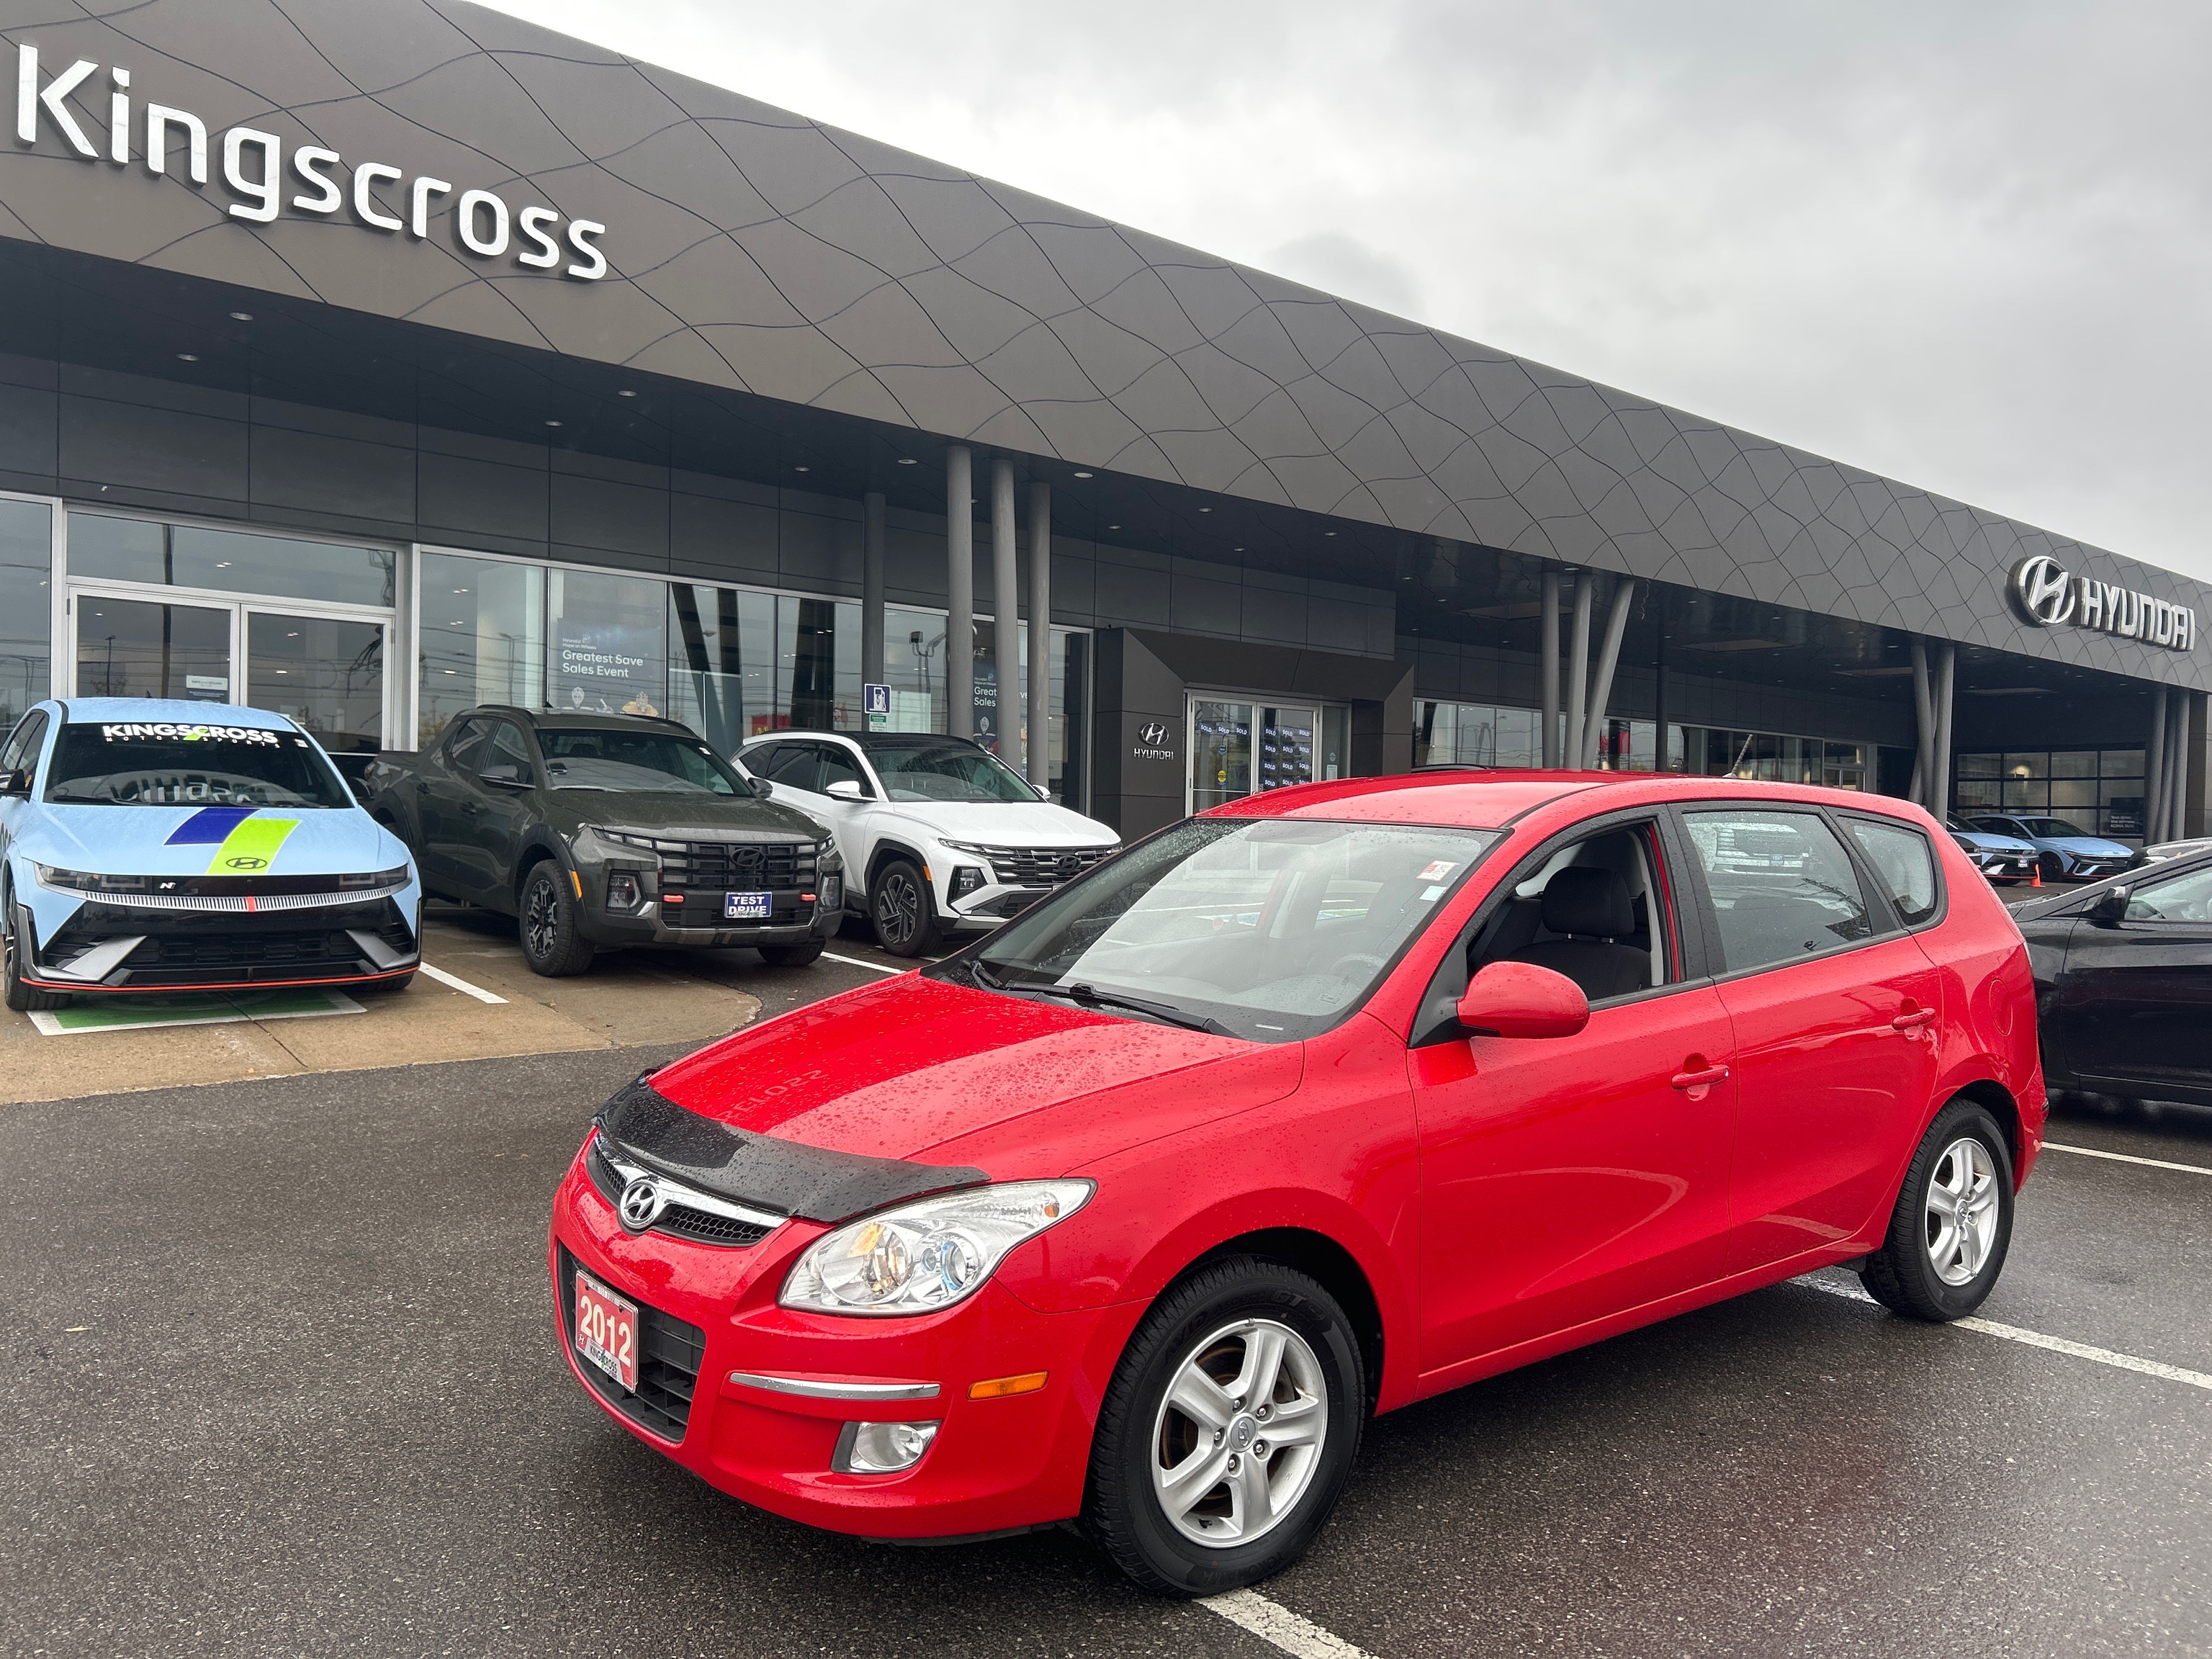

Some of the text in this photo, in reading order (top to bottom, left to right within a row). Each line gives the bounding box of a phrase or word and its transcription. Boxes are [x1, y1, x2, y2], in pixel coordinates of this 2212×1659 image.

[17, 43, 607, 280] Kingscross
[2081, 577, 2195, 651] HYUNDAI
[562, 649, 644, 666] Greatest Save
[562, 662, 629, 678] Sales Event
[974, 686, 997, 696] Great
[974, 696, 997, 707] Sales
[102, 724, 278, 744] KINGSCROSS
[1200, 724, 1213, 733] SOLD
[1218, 726, 1230, 734] SOLD
[1133, 747, 1174, 760] HYUNDAI
[732, 896, 765, 905] TEST
[728, 906, 768, 915] DRIVE
[580, 1295, 631, 1368] 2012
[590, 1345, 618, 1374] KINGSCROSS
